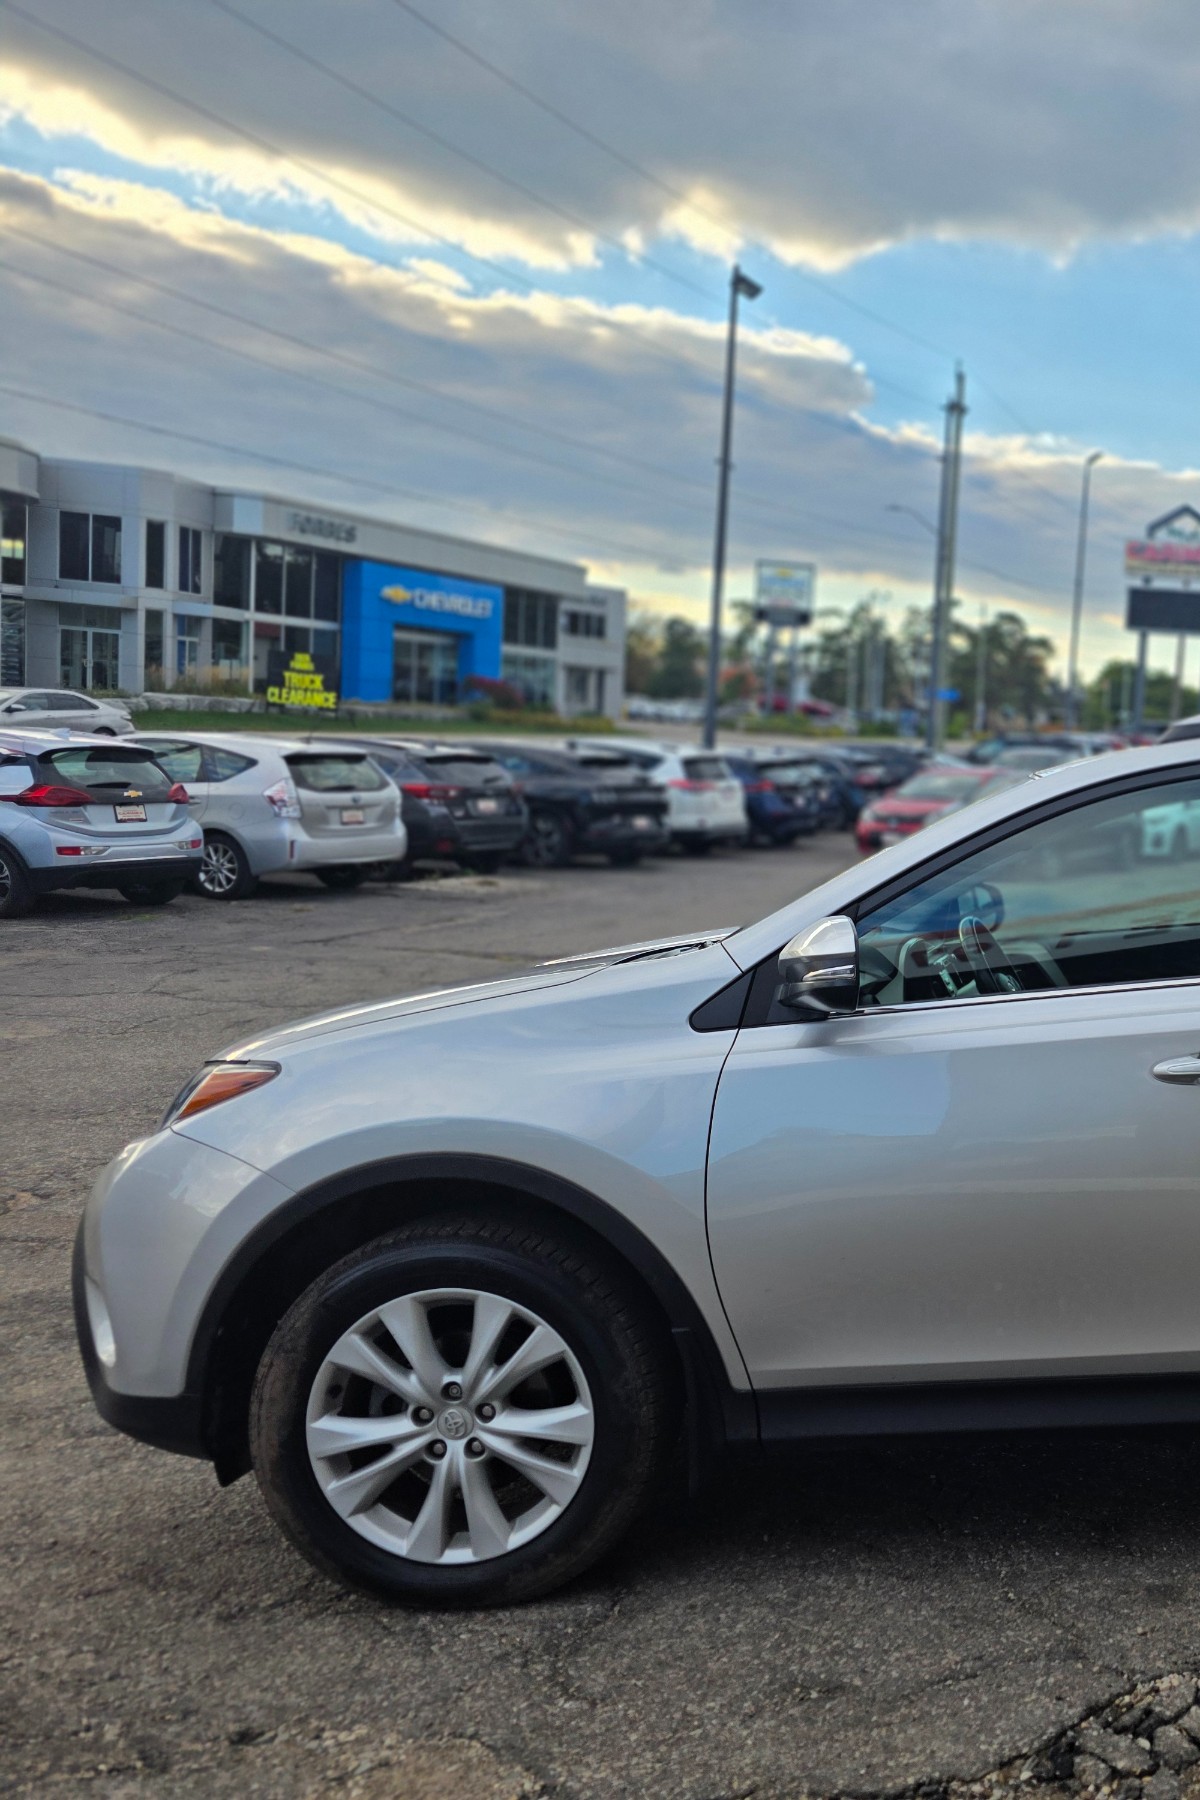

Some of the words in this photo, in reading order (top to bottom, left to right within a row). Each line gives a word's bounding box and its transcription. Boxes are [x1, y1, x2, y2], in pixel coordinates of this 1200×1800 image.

[413, 588, 494, 618] CHEVROLET
[283, 671, 324, 691] TRUCK
[267, 686, 337, 709] CLEARANCE
